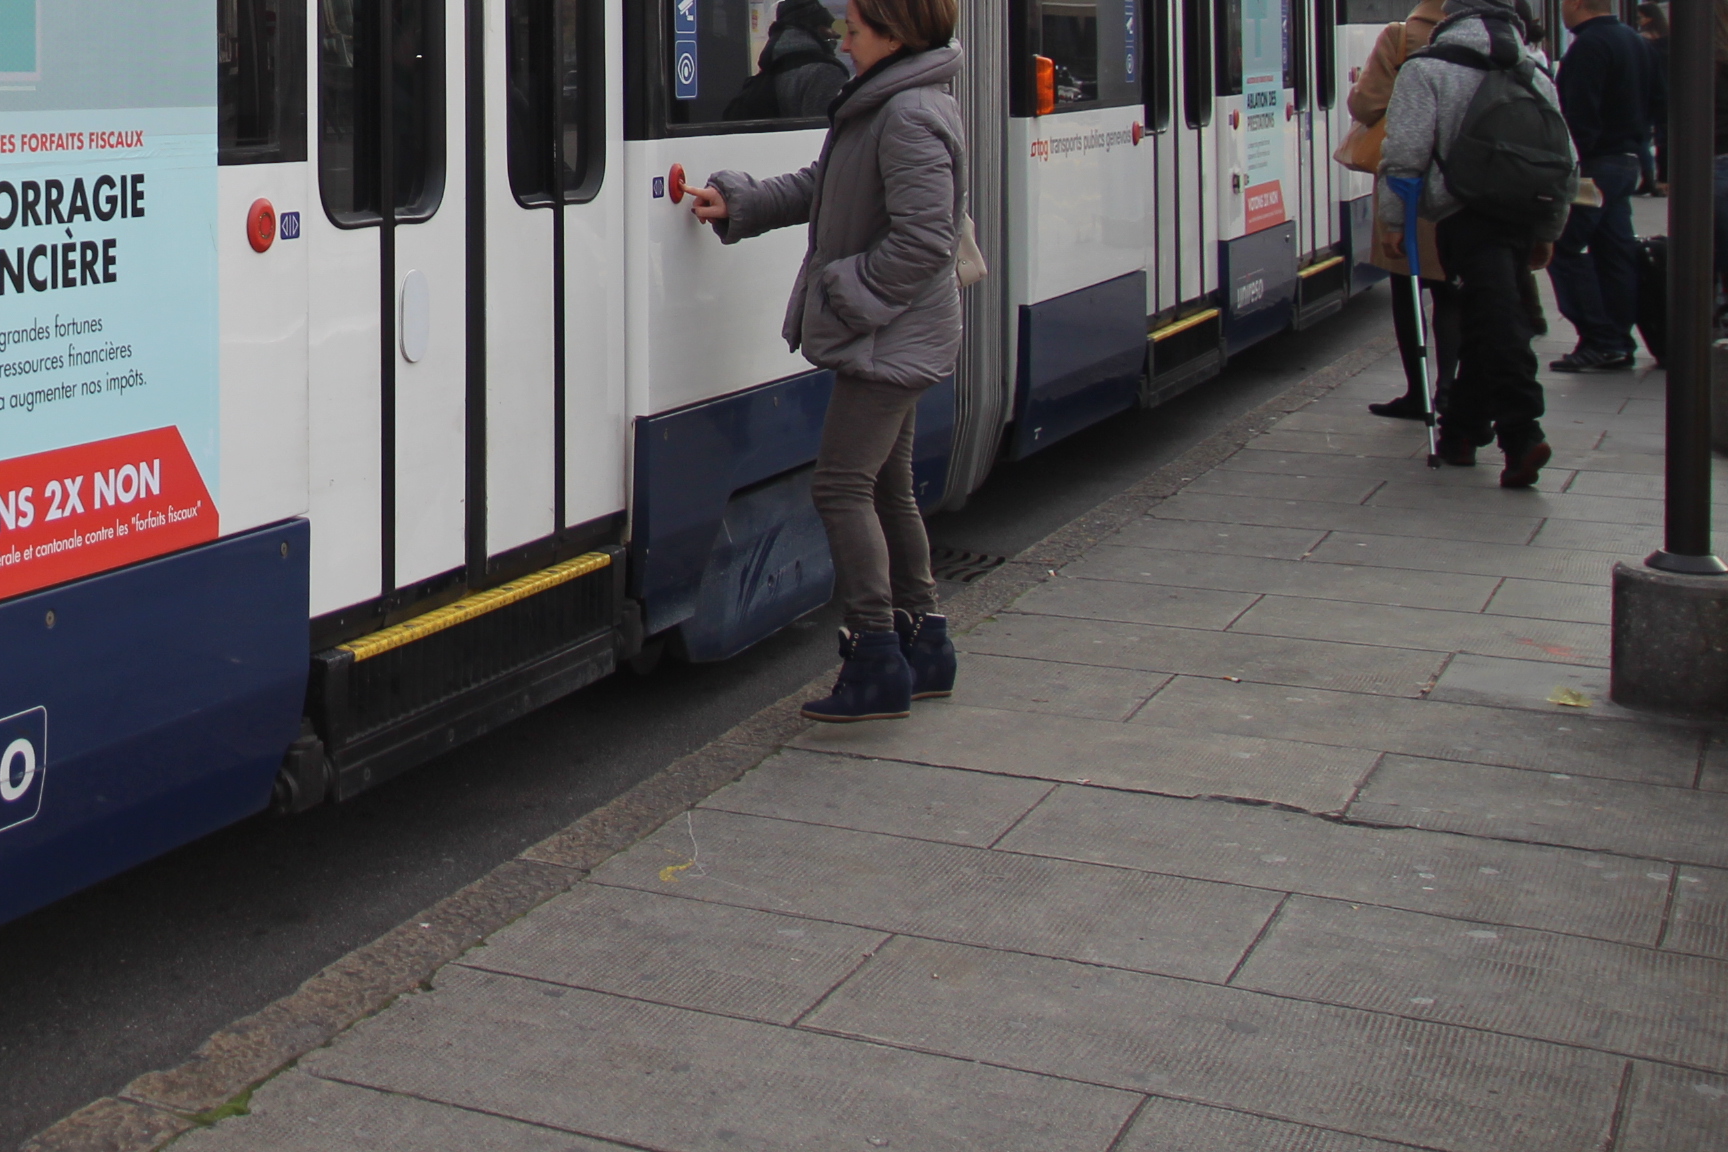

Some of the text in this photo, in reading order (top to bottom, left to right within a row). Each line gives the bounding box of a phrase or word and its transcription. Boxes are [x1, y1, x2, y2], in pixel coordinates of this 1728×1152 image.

[21, 132, 84, 152] FORFAITS
[89, 130, 144, 149] FISCAUX
[1050, 134, 1082, 158] transports
[1083, 129, 1105, 156] publics
[1106, 126, 1132, 152] genevois
[54, 314, 103, 338] fortunes
[68, 341, 133, 368] financières
[9, 382, 77, 412] augmenter
[81, 378, 102, 397] nos
[106, 368, 147, 396] impôts.
[44, 475, 85, 522] 2X
[93, 458, 160, 510] NON
[23, 547, 33, 561] et
[35, 536, 83, 559] cantonale
[85, 526, 114, 545] contre
[116, 519, 129, 537] les
[131, 507, 166, 533] "forfaits
[167, 500, 202, 524] fiscaux"
